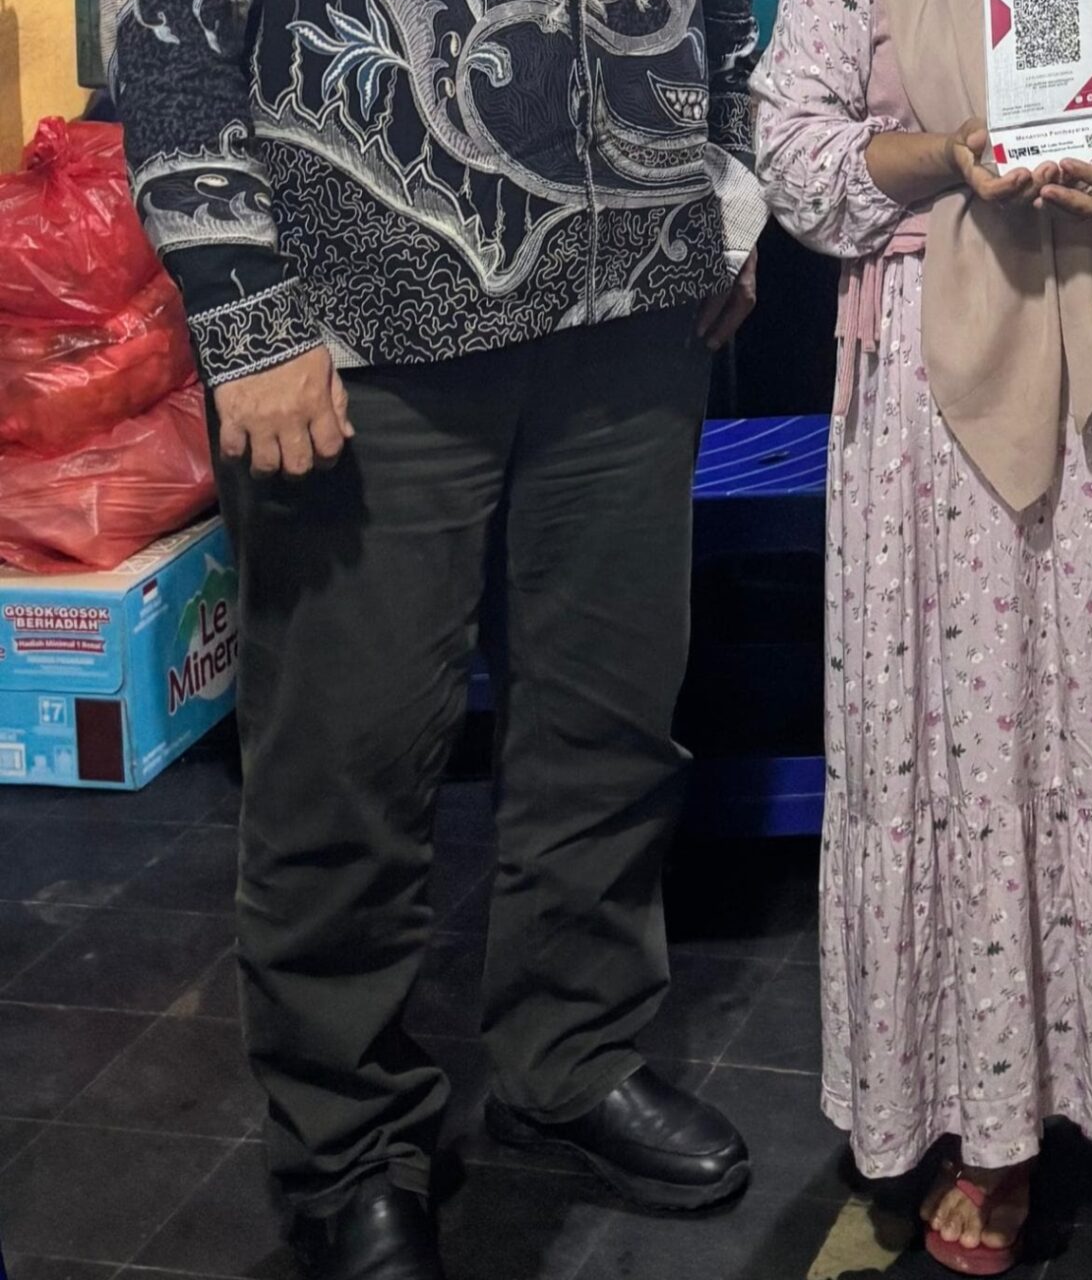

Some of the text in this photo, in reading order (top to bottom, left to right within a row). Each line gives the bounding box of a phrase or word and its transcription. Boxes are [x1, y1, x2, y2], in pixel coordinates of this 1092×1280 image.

[1008, 140, 1040, 160] QRIS
[16, 618, 98, 630] BERHADIAH
[200, 601, 227, 645] Le
